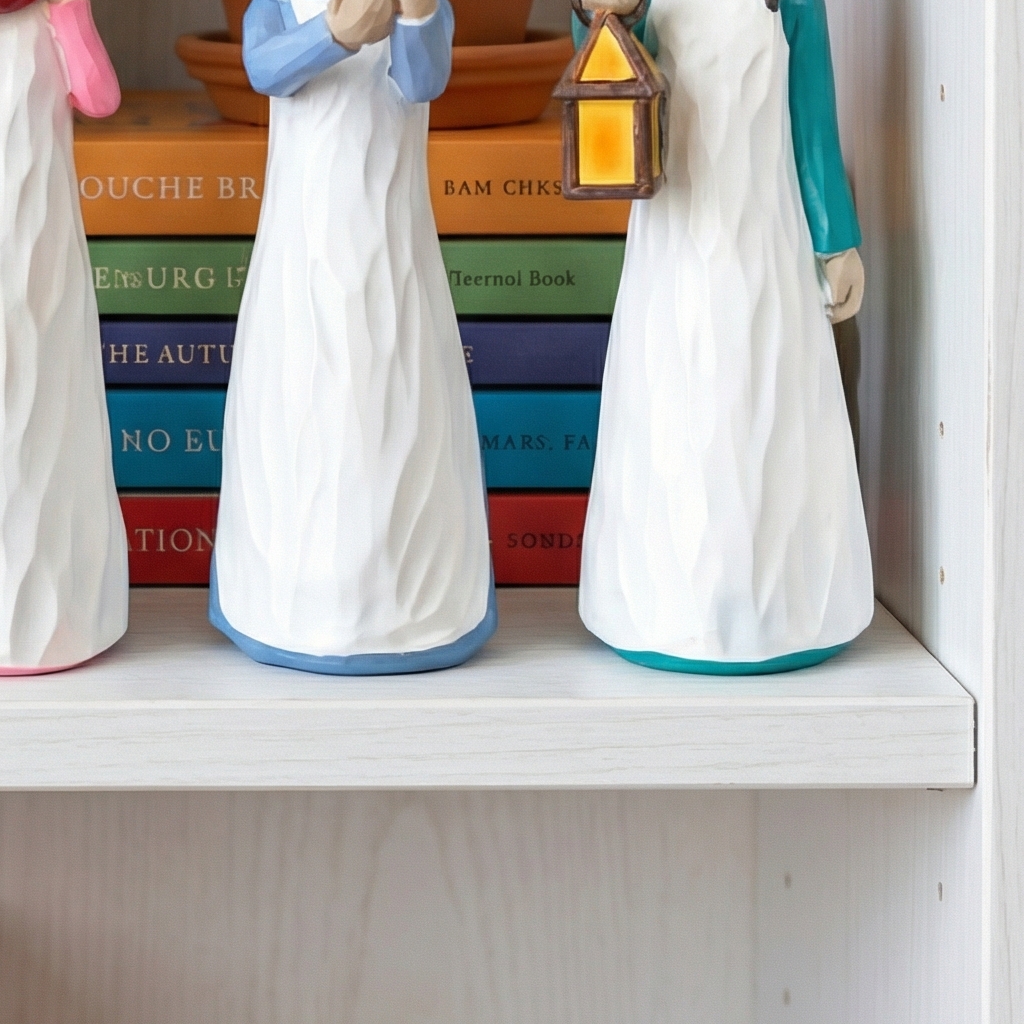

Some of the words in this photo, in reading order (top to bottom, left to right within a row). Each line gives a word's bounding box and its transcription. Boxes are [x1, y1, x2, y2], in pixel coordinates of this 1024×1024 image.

[444, 179, 492, 196] BAM
[529, 269, 577, 287] Book
[103, 344, 149, 364] HE
[121, 429, 171, 452] NO
[127, 528, 215, 553] TION
